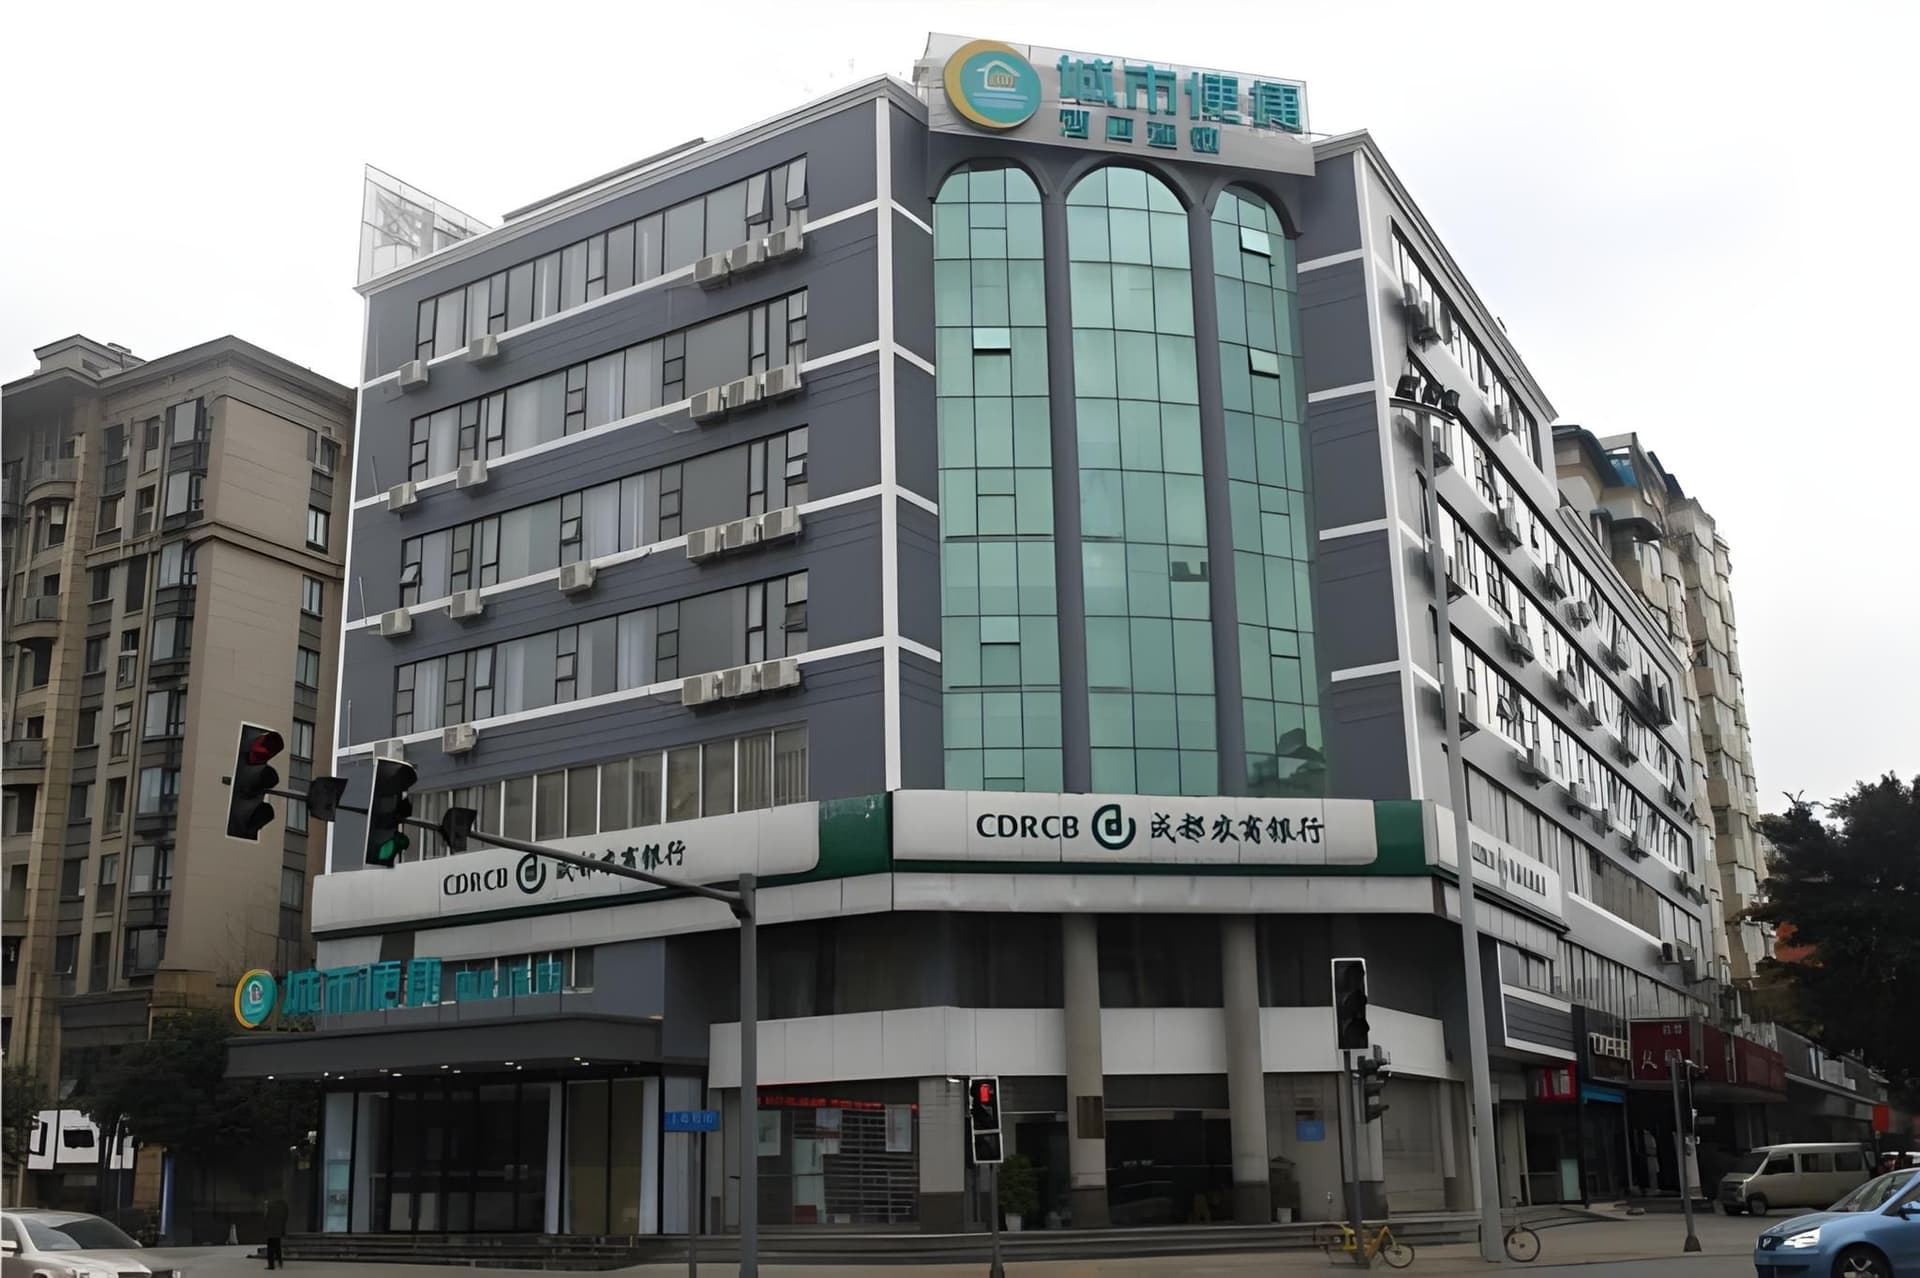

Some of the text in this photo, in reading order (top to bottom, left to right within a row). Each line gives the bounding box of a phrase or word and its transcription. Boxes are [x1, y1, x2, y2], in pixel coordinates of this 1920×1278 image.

[976, 813, 1079, 839] CDRCB
[1151, 812, 1325, 844] 成都农商银行
